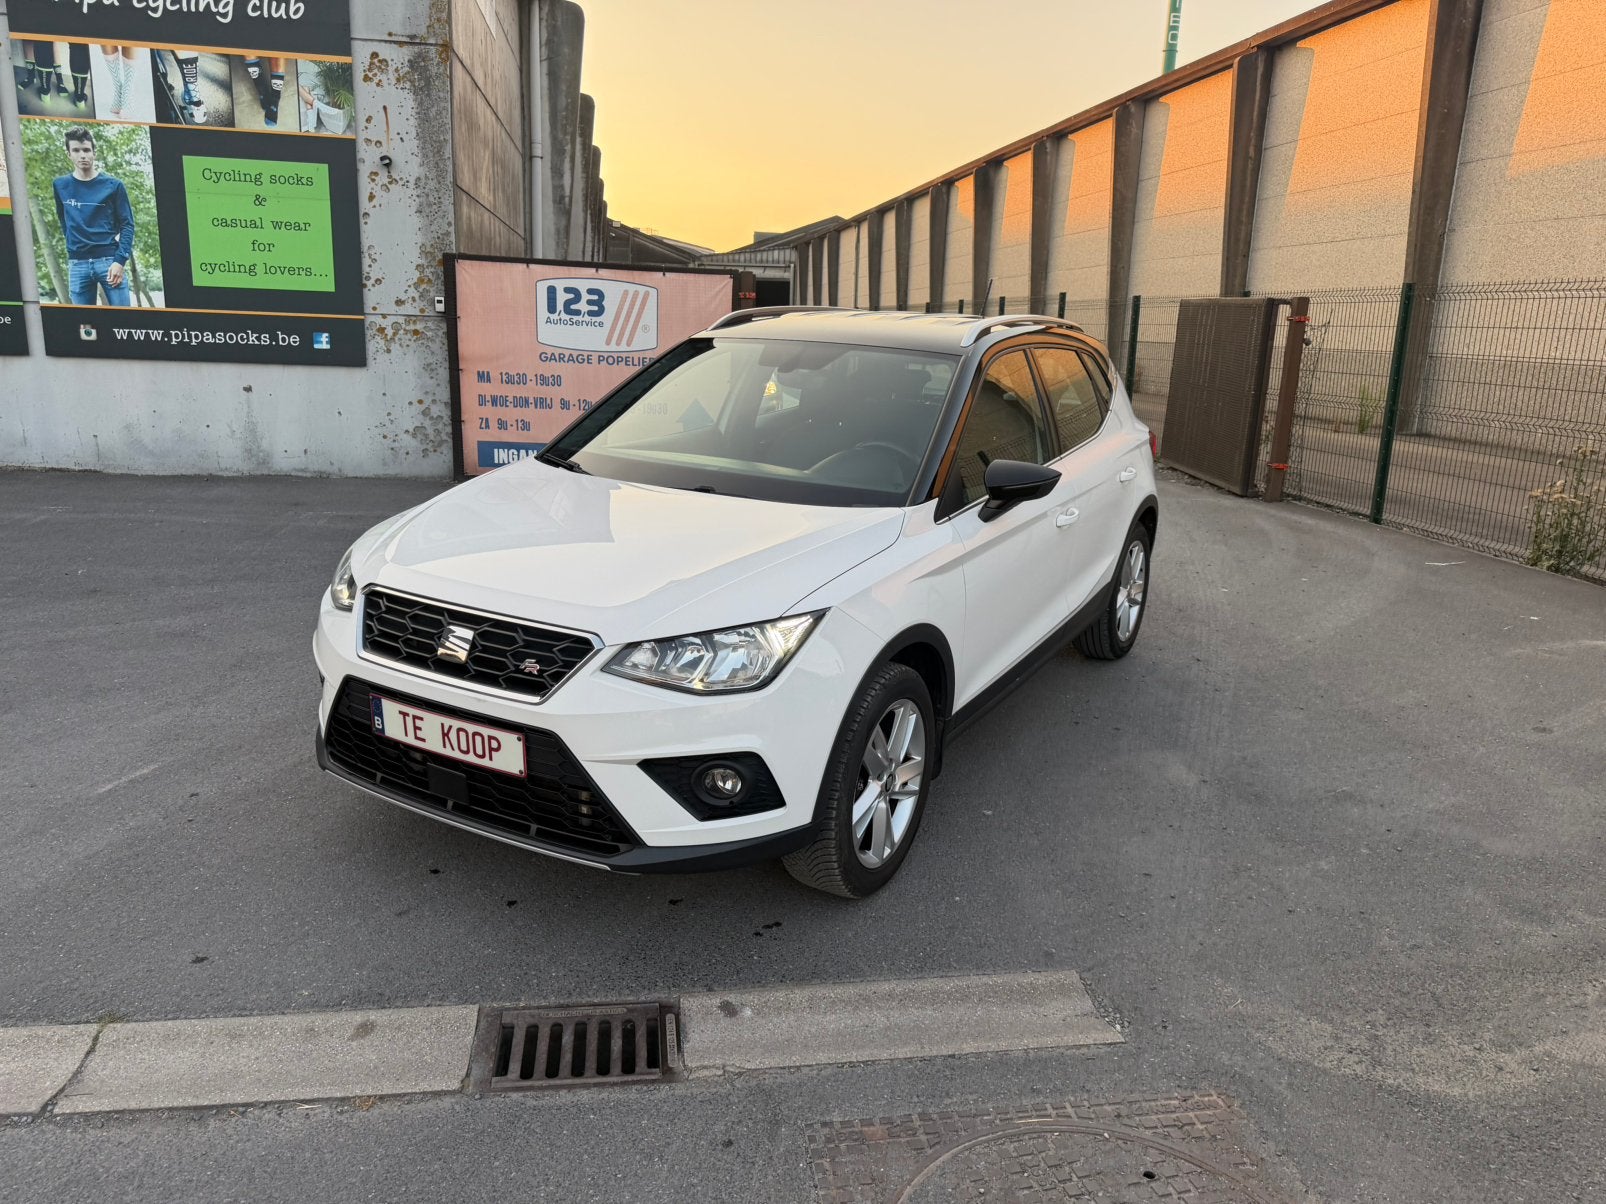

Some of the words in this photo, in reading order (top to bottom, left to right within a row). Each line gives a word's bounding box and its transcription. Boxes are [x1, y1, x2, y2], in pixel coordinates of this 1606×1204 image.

[247, 0, 305, 19] club
[202, 168, 263, 186] Cycling
[269, 173, 314, 186] socks
[253, 194, 267, 206] &
[211, 217, 264, 229] casual
[270, 219, 311, 231] wear
[251, 239, 275, 252] for
[200, 260, 257, 277] cycling
[263, 262, 328, 277] lovers...
[545, 316, 604, 328] AutoService
[112, 325, 300, 348] www.pipasocks.be
[539, 352, 593, 365] GARAGE
[477, 370, 491, 384] MA
[560, 397, 571, 411] 9u
[479, 417, 490, 430] ZA
[497, 417, 508, 431] 9u
[516, 418, 531, 432] 13u
[374, 715, 383, 729] B
[398, 710, 427, 743] TE
[440, 722, 502, 762] KOOP
